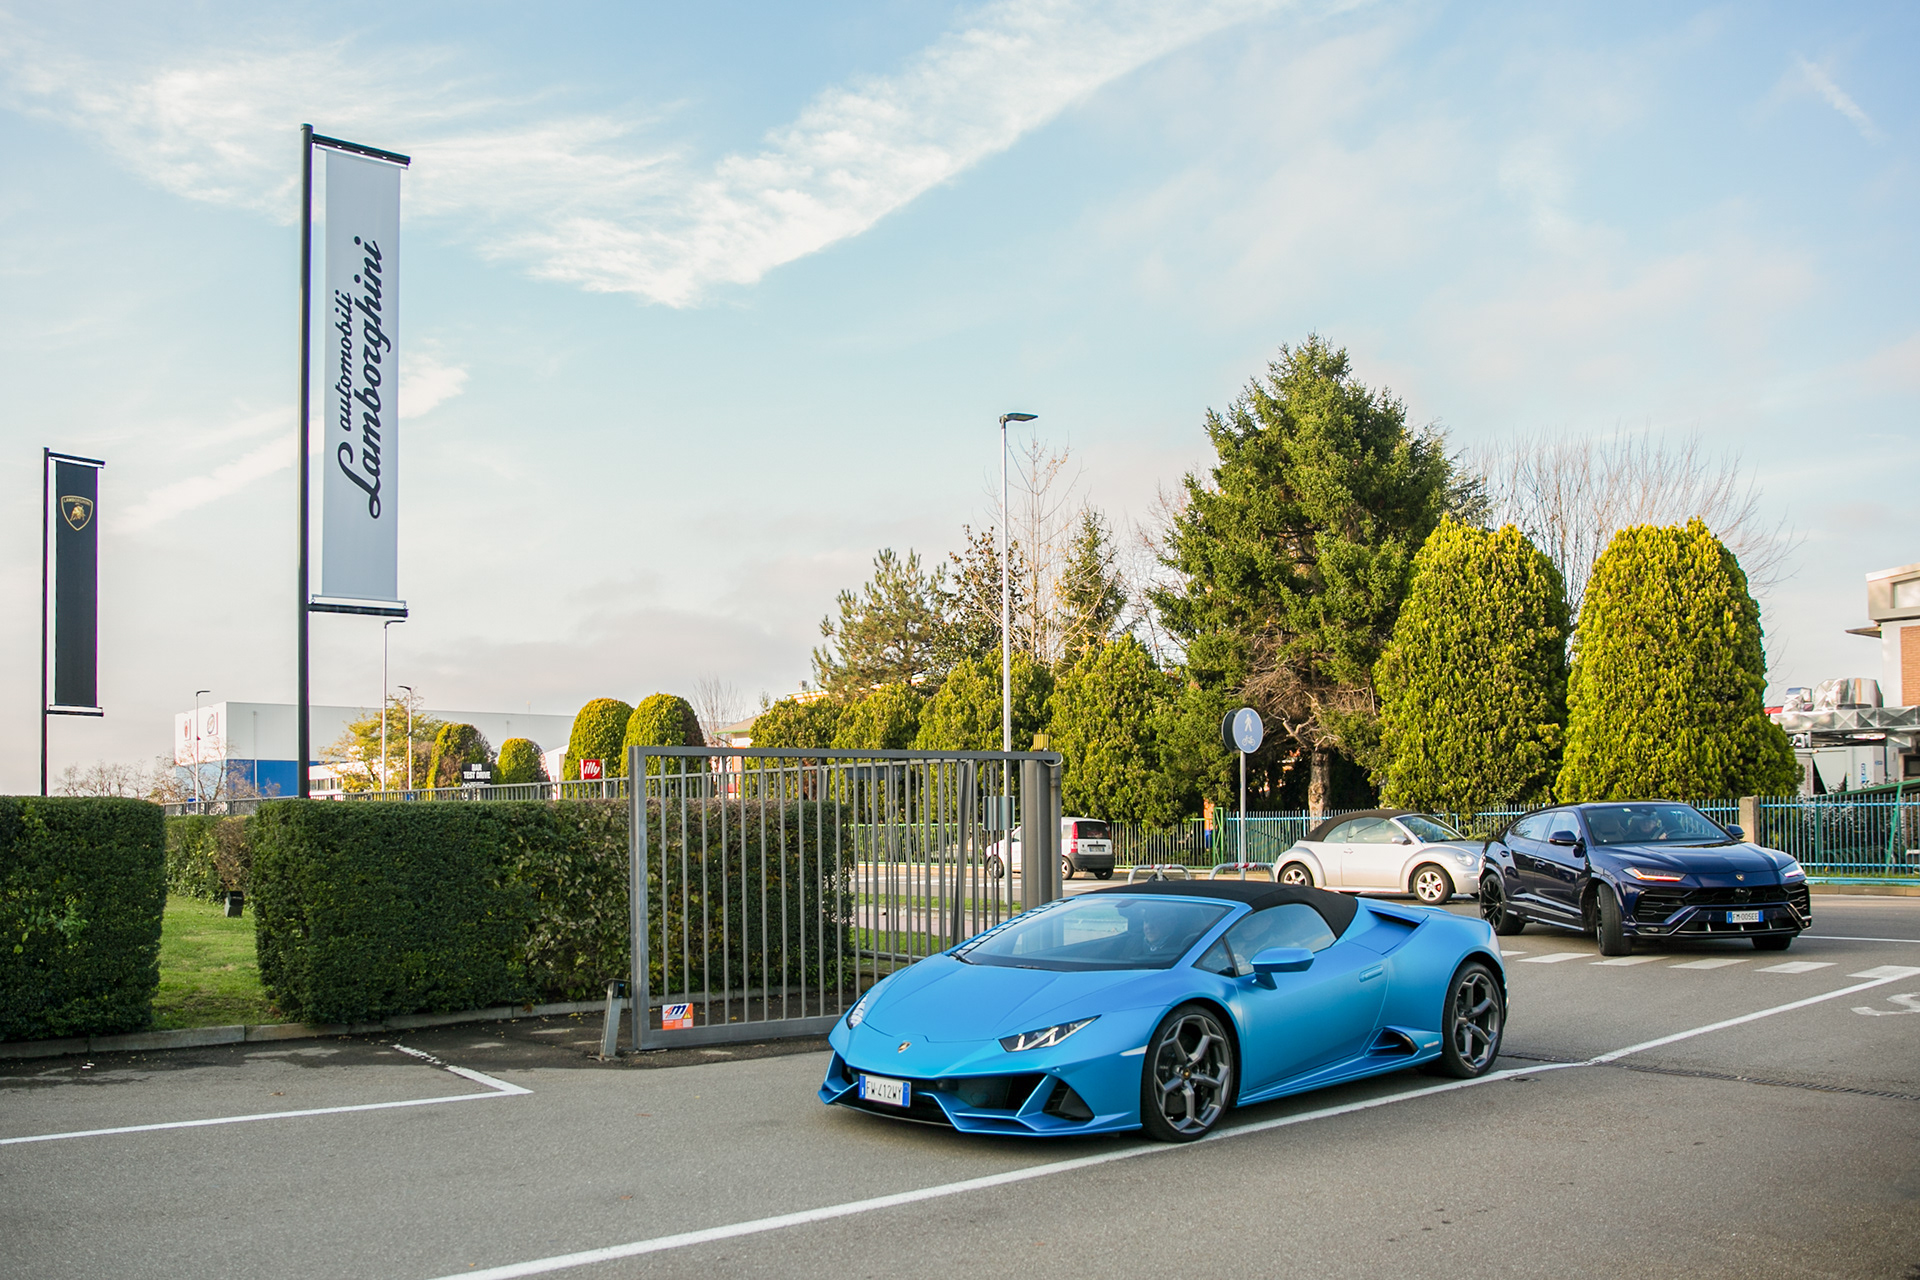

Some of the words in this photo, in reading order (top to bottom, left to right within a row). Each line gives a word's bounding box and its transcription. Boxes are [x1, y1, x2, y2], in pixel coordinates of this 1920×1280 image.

[335, 289, 352, 432] automobili
[338, 236, 391, 519] Lamborghini
[584, 761, 600, 777] illy
